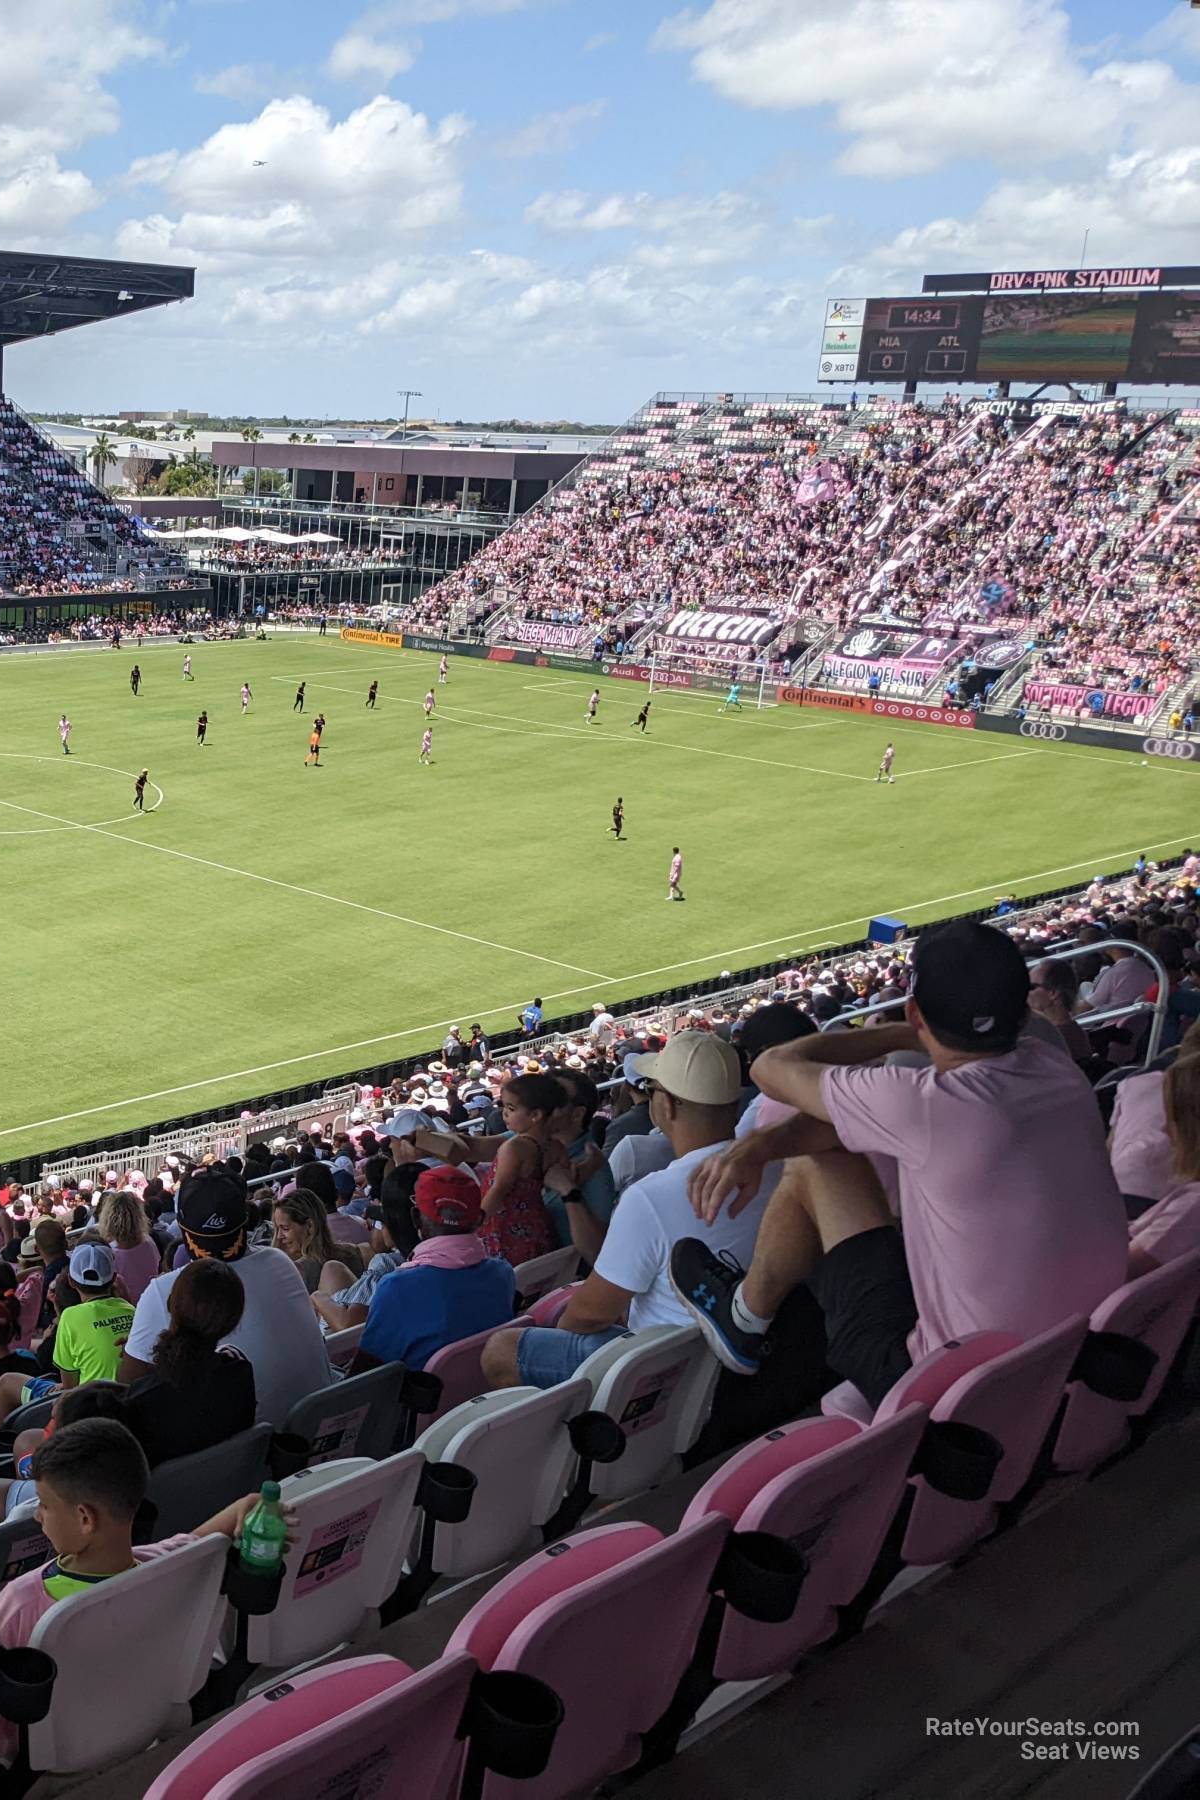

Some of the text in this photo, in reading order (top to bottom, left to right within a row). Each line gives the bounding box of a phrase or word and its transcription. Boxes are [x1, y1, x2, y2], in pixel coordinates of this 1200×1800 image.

[990, 268, 1161, 289] DRV PNK STADIUM
[903, 309, 941, 324] 14:34
[878, 336, 900, 347] MIA
[937, 335, 960, 347] ATL
[881, 354, 893, 369] 0
[943, 354, 949, 369] 1
[1030, 400, 1115, 417] PRESENTE
[342, 629, 400, 645] Continental TIRE
[517, 622, 581, 646] SIEGE MIAMI
[611, 667, 635, 677] Audi
[833, 658, 874, 679] LEGION
[782, 689, 854, 708] Continental
